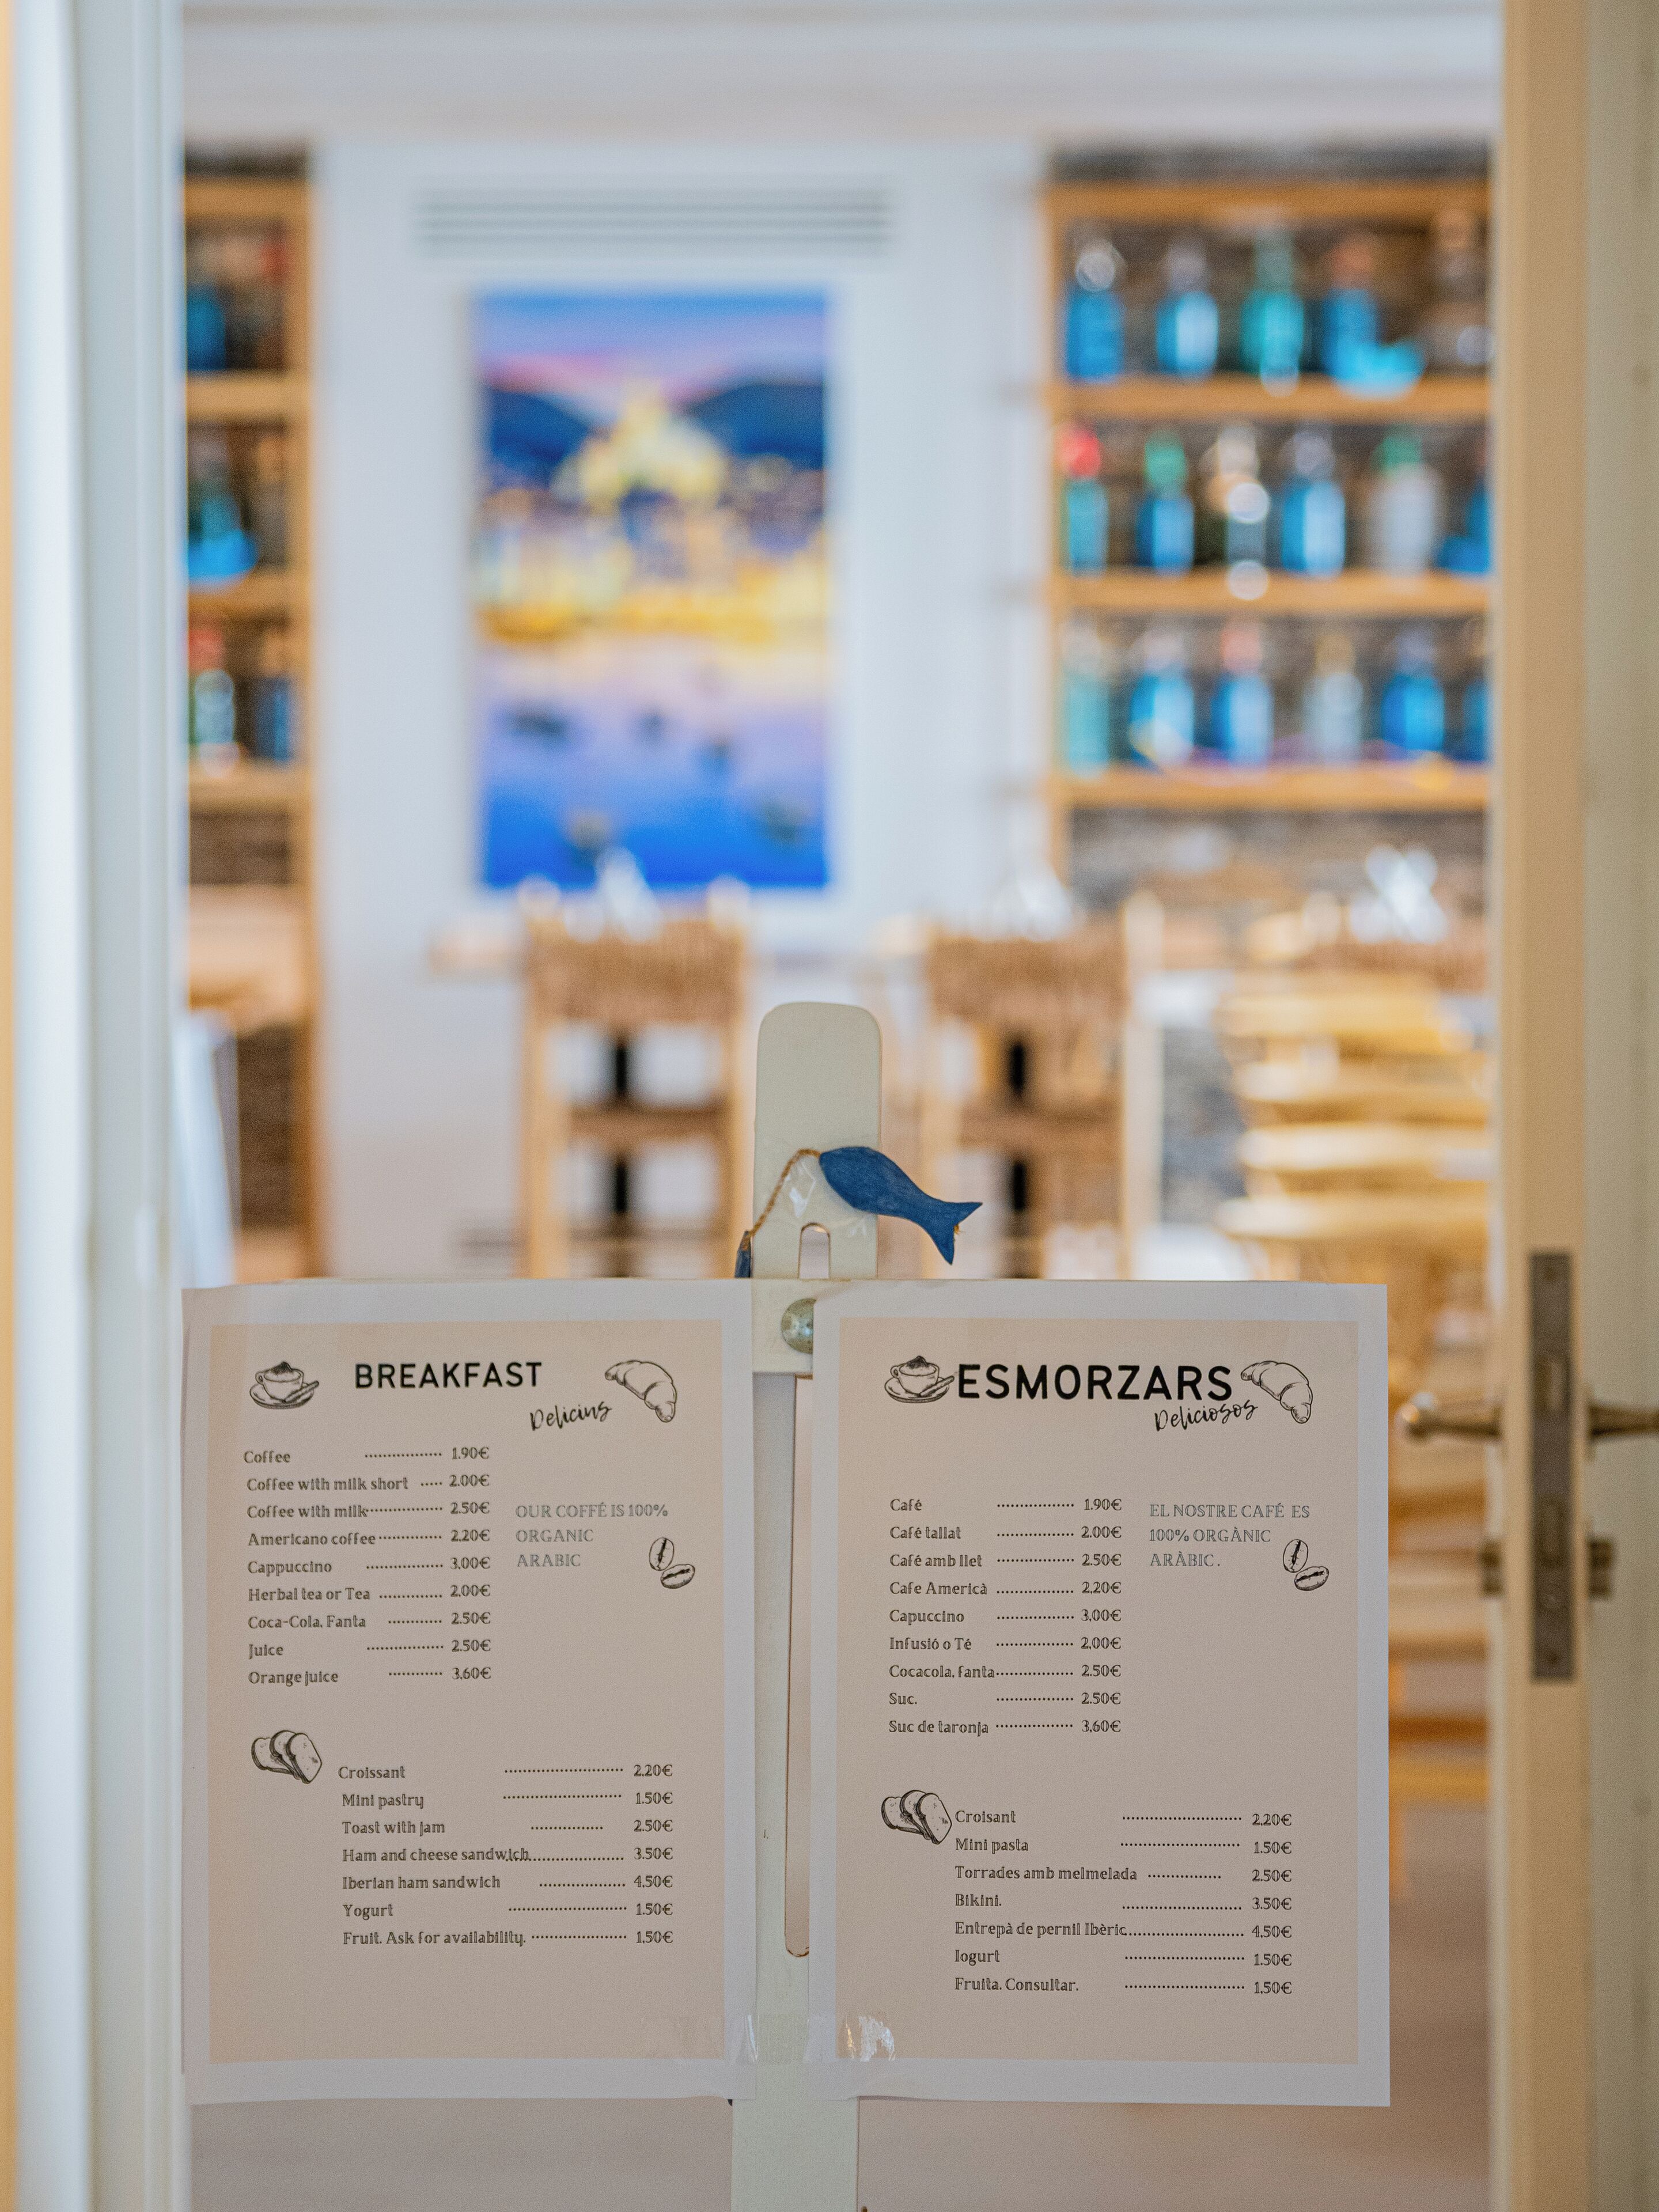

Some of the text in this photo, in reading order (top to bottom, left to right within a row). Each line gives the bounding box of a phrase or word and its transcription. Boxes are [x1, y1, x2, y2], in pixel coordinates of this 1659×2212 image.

[355, 1362, 542, 1389] BREAKFAST
[959, 1363, 1232, 1401] ESMORZARS
[1154, 1400, 1257, 1431] Deliciosos
[243, 1446, 489, 1463] Coffee 1.90€
[247, 1474, 489, 1491] Coffee with milk short 2.00€
[247, 1502, 490, 1518] Coffee with milk 2.50€
[516, 1502, 668, 1518] OUR COFFÉ IS 100%
[890, 1498, 1122, 1511] Café 1.90€
[1150, 1502, 1310, 1518] EL NOSTRE CAFÉ ES
[248, 1533, 328, 1546] Americano
[331, 1532, 376, 1545] coffee
[516, 1529, 593, 1542] ORGANIC
[889, 1525, 1122, 1539] Café tallat 2.00€
[1150, 1527, 1271, 1542] 100% ORGÀNIC
[517, 1554, 581, 1567] ARABIC
[889, 1553, 1122, 1567] Café amb llet 2.50€
[247, 1560, 332, 1577] Cappuccino
[249, 1588, 298, 1601] Herbal
[301, 1588, 323, 1600] tea
[325, 1590, 342, 1600] or
[345, 1587, 370, 1600] Tea
[889, 1581, 922, 1594] Cafe
[926, 1581, 987, 1595] Americà
[327, 1615, 366, 1628] Fanta
[451, 1612, 491, 1624] 2.50€
[889, 1609, 964, 1626] Capuccino
[249, 1639, 491, 1660] Juice 2.50€
[889, 1637, 940, 1650] Infusió
[942, 1641, 951, 1650] o
[955, 1637, 972, 1650] Té
[248, 1671, 302, 1687] Orange
[305, 1671, 339, 1686] juice
[958, 1665, 995, 1678] fanta
[1081, 1664, 1121, 1677] 2.50€
[889, 1692, 1121, 1705] Suc. 2.50€
[889, 1720, 914, 1733] Suc
[918, 1720, 934, 1733] de
[938, 1720, 988, 1737] taronja
[338, 1766, 405, 1779] Croissant
[342, 1791, 673, 1810] Mini pastry 1.50€
[955, 1810, 1016, 1823] Croisant
[342, 1819, 673, 1836] Toast with jam 2.50€
[343, 1847, 673, 1862] Ham and cheese sandwich 3.50€
[956, 1838, 1291, 1855] Mini pasta 1.50€
[955, 1865, 1291, 1882] Torrades amb melmelada 2.50€
[343, 1876, 394, 1889] Iberian
[398, 1876, 429, 1889] ham
[433, 1875, 501, 1888] sandwich
[955, 1893, 1291, 1910] Bikini. 3.50€
[343, 1903, 673, 1921] Yogurt 1.50€
[955, 1921, 1013, 1938] Entrepà
[1016, 1922, 1033, 1935] de
[1037, 1922, 1081, 1939] pernil
[343, 1931, 382, 1945] Fruit.
[386, 1931, 414, 1944] Ask
[418, 1931, 440, 1944] for
[444, 1930, 526, 1947] availability.
[955, 1949, 1291, 1966] Iogurt 1.50€
[955, 1977, 1002, 1990] Fruita.
[1005, 1978, 1079, 1991] Consultar.
